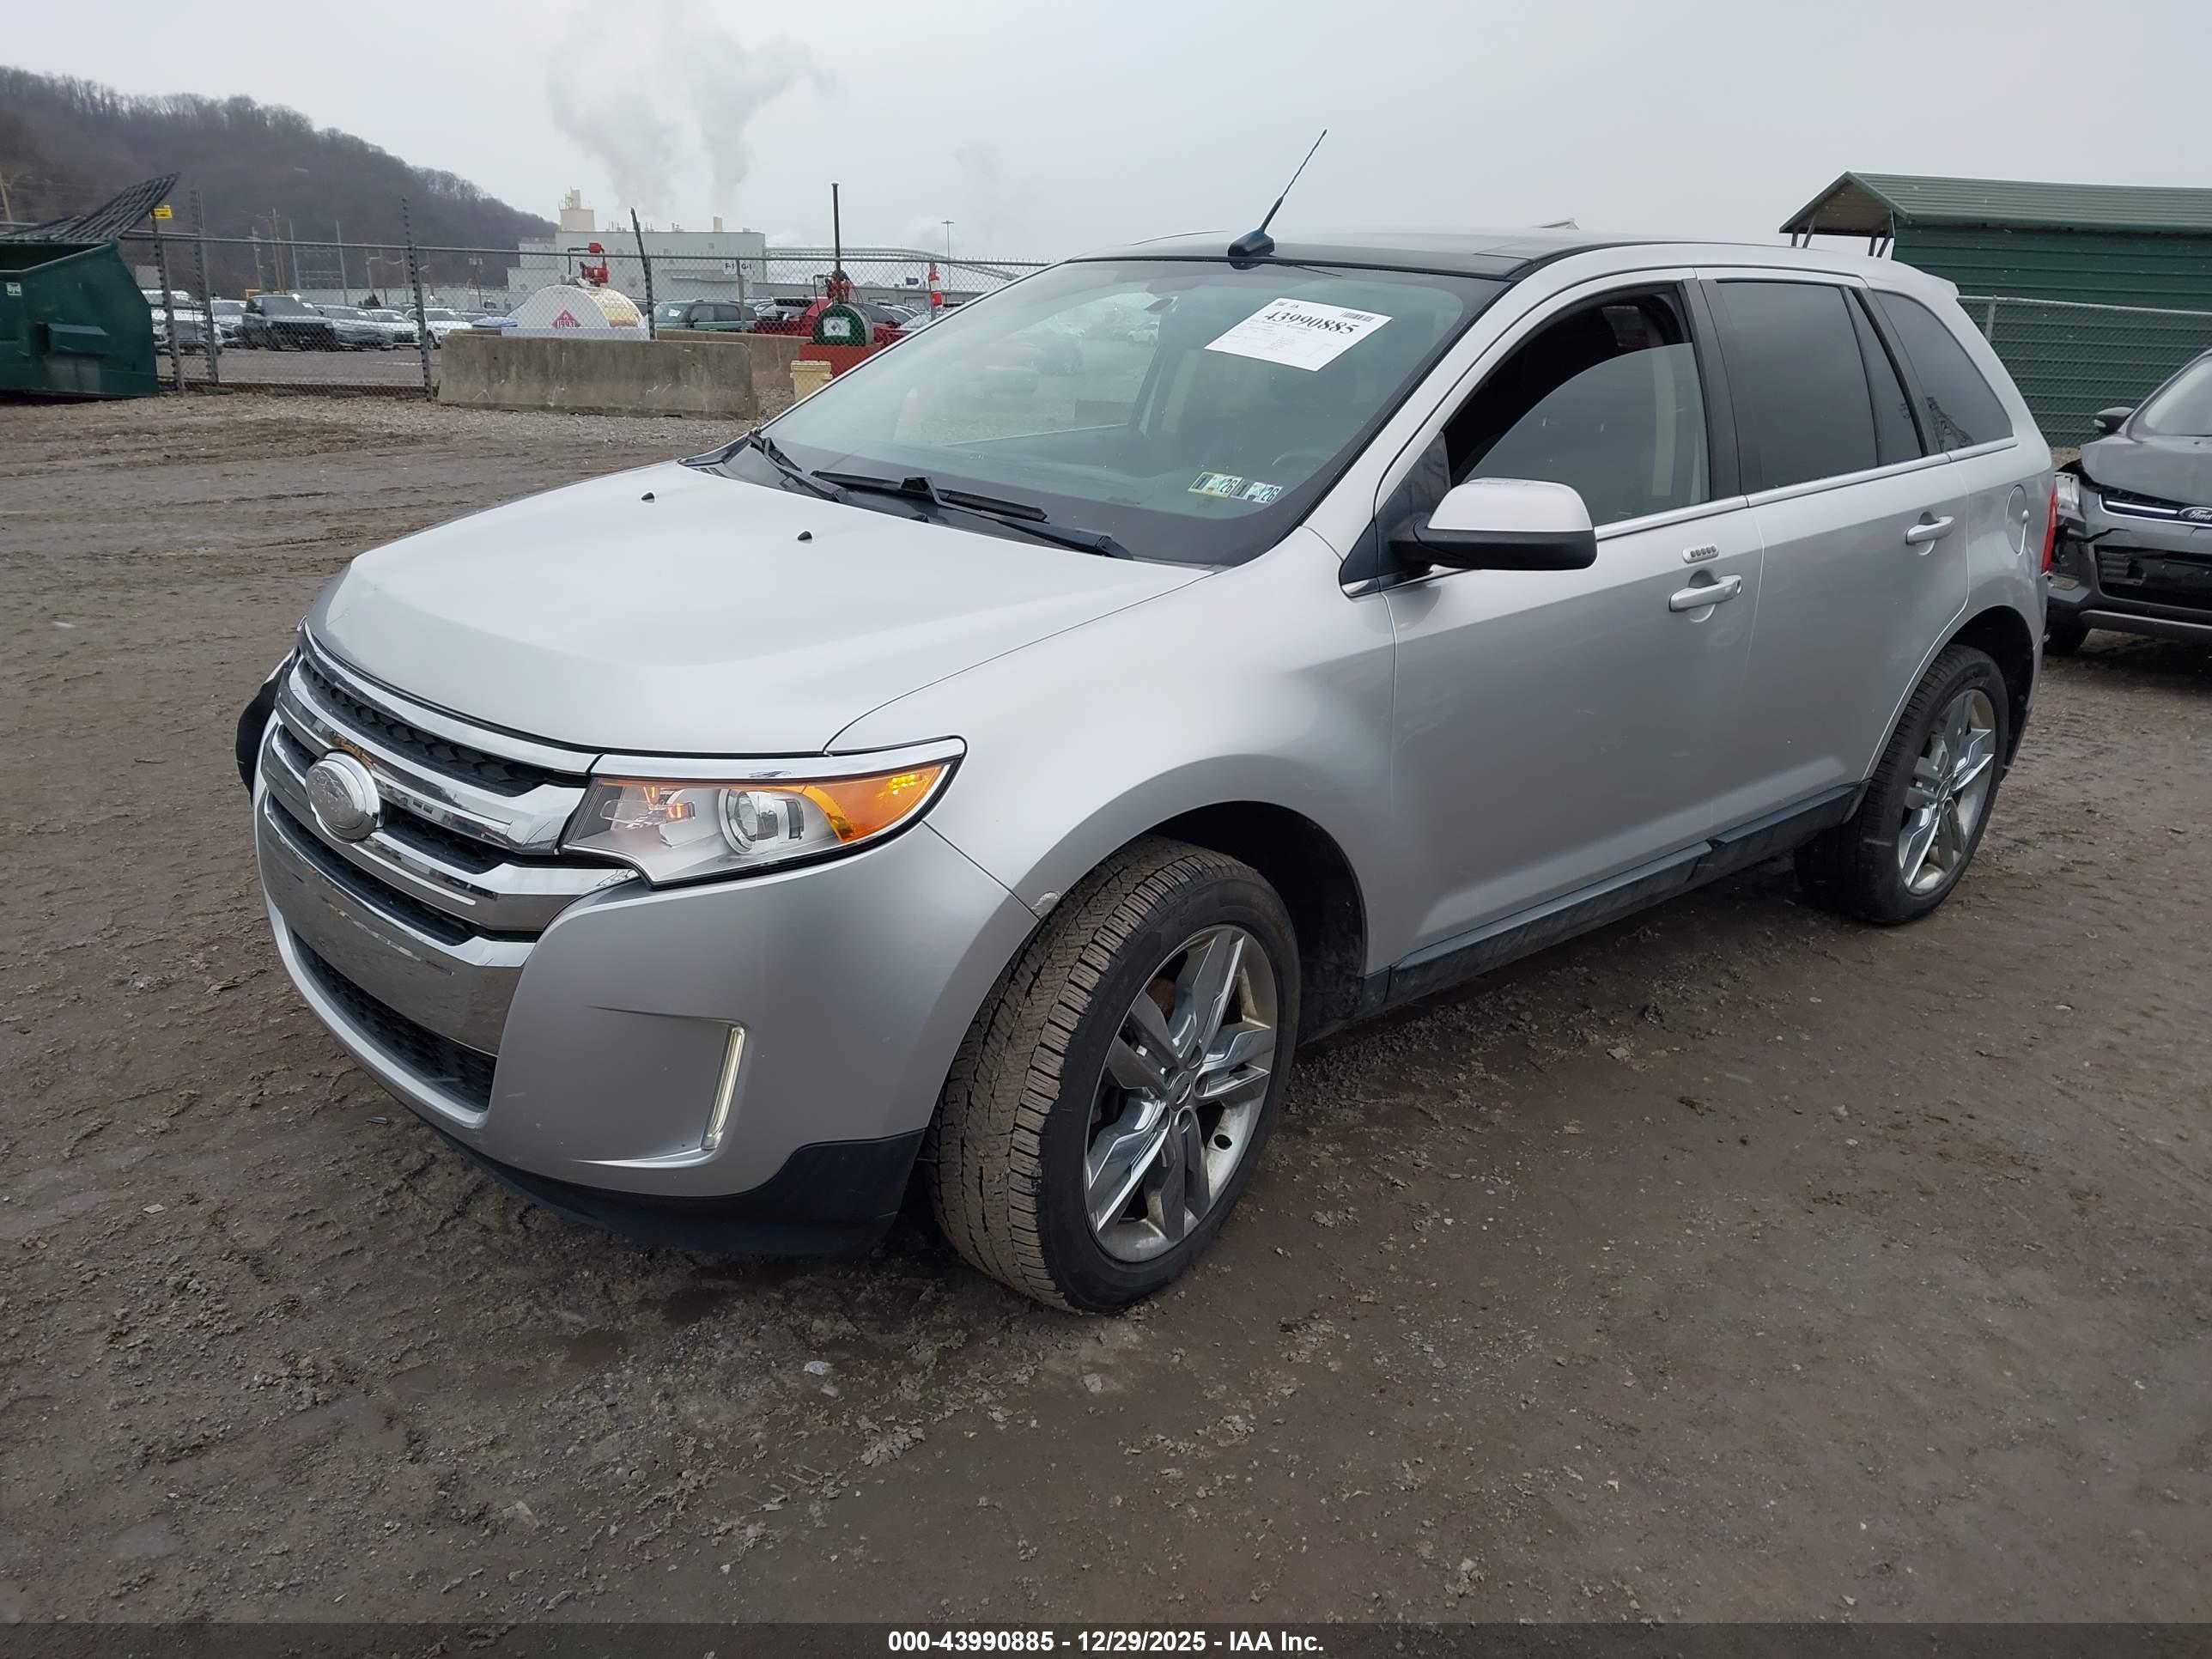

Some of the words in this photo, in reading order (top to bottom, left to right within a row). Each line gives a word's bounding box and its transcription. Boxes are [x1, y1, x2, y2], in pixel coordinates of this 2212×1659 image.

[1263, 310, 1362, 335] 43990885
[1219, 478, 1238, 494] 26
[1261, 486, 1279, 502] 26
